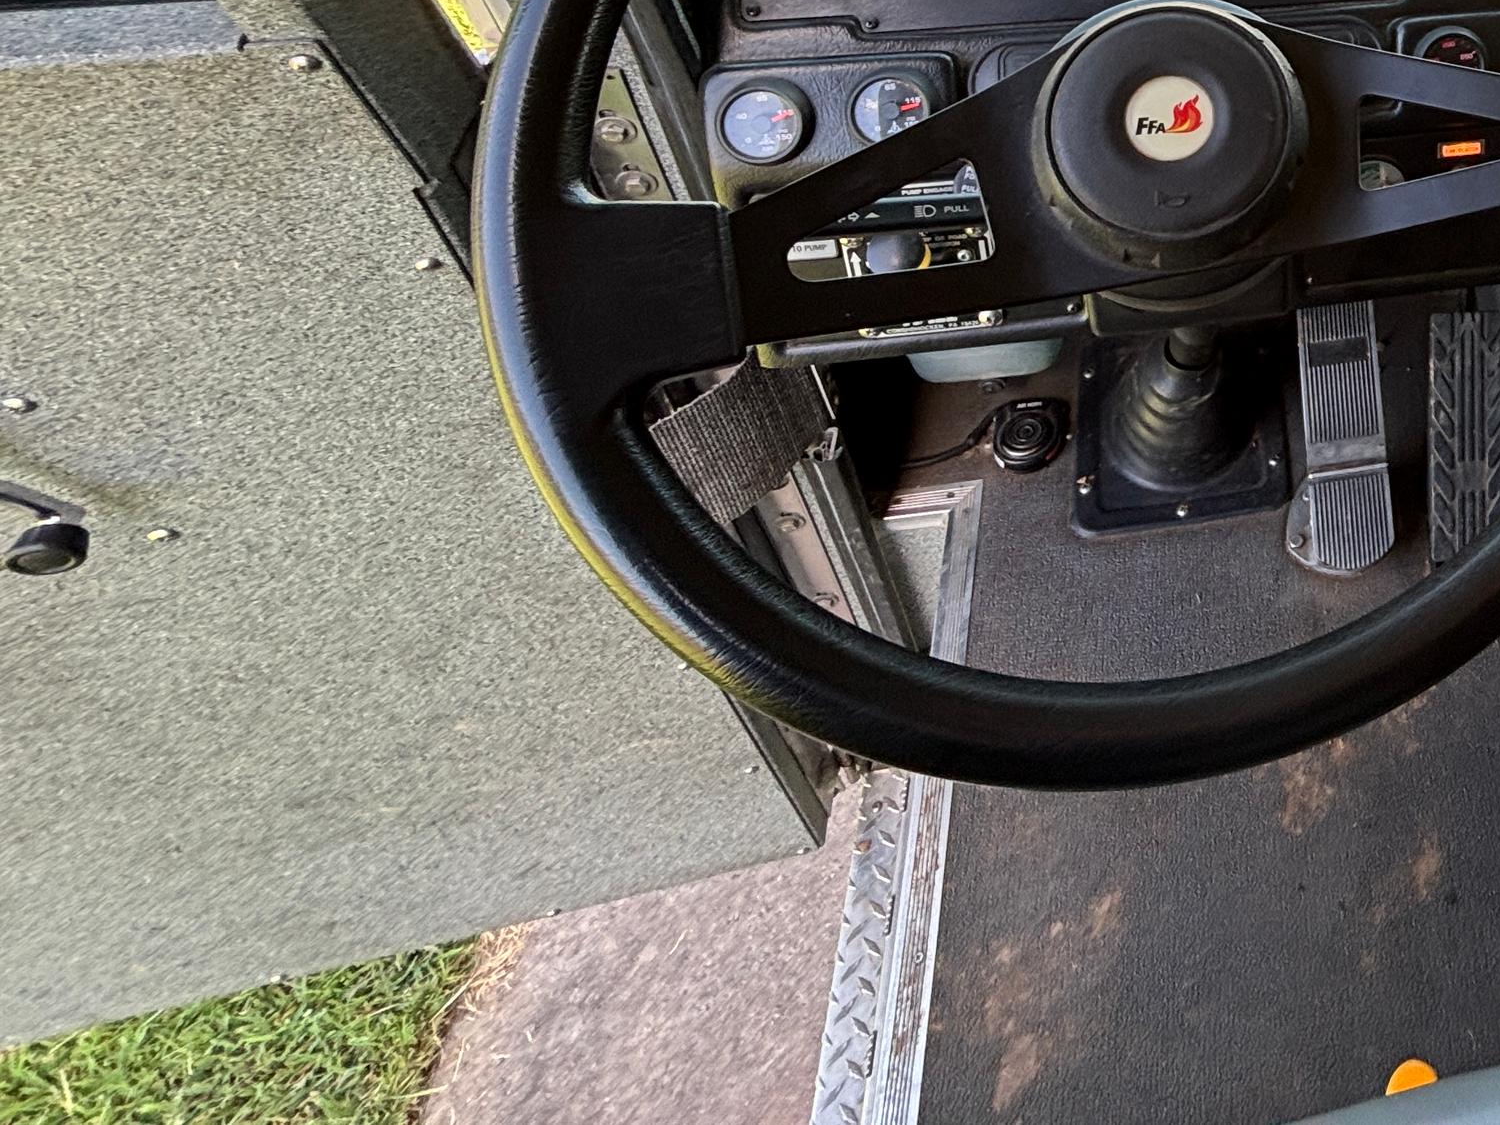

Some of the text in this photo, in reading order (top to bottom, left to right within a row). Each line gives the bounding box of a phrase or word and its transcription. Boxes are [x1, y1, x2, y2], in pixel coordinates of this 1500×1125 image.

[1136, 117, 1167, 135] FFA
[944, 205, 970, 213] PULL
[804, 244, 827, 252] PUMP
